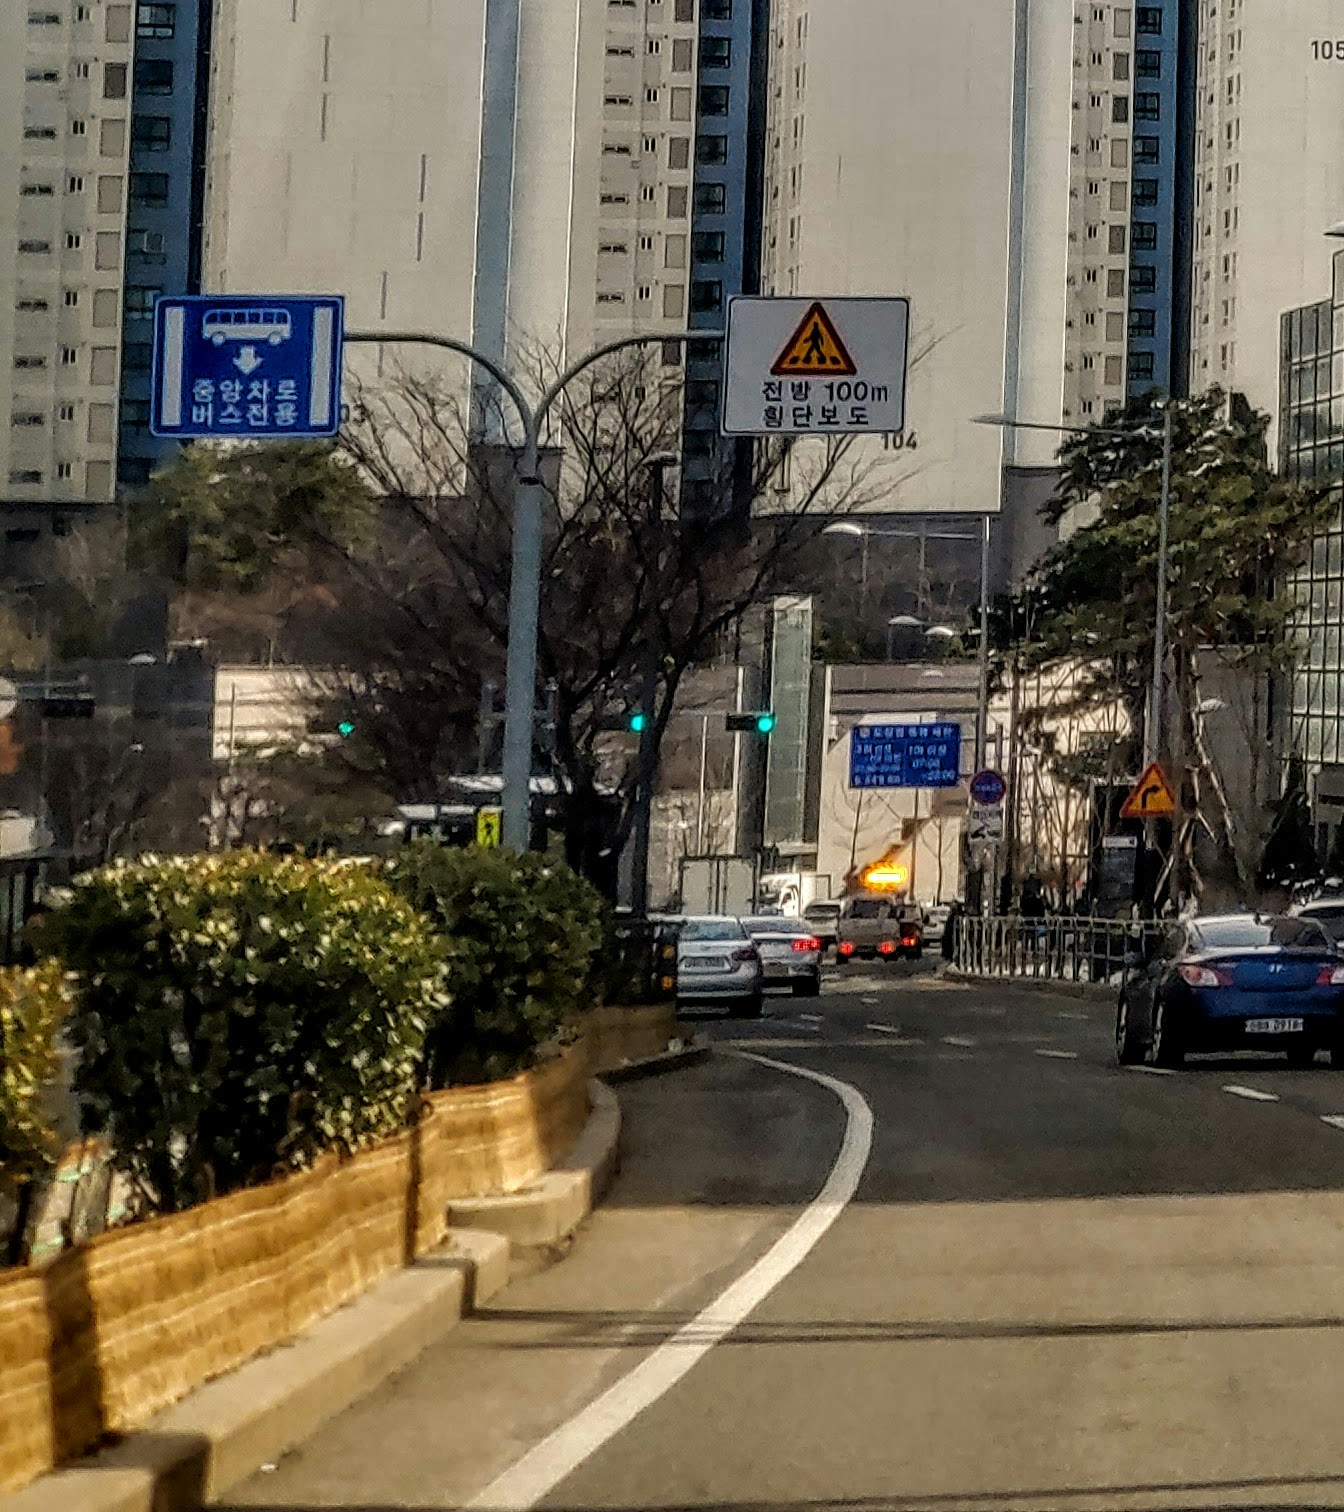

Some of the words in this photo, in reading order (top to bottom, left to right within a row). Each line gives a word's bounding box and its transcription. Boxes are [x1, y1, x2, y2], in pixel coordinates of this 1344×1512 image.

[192, 377, 298, 403] 중앙차로
[762, 380, 812, 402] 전방
[824, 381, 888, 403] 100m
[192, 402, 299, 428] 버스전용
[763, 405, 870, 428] 횡단보도
